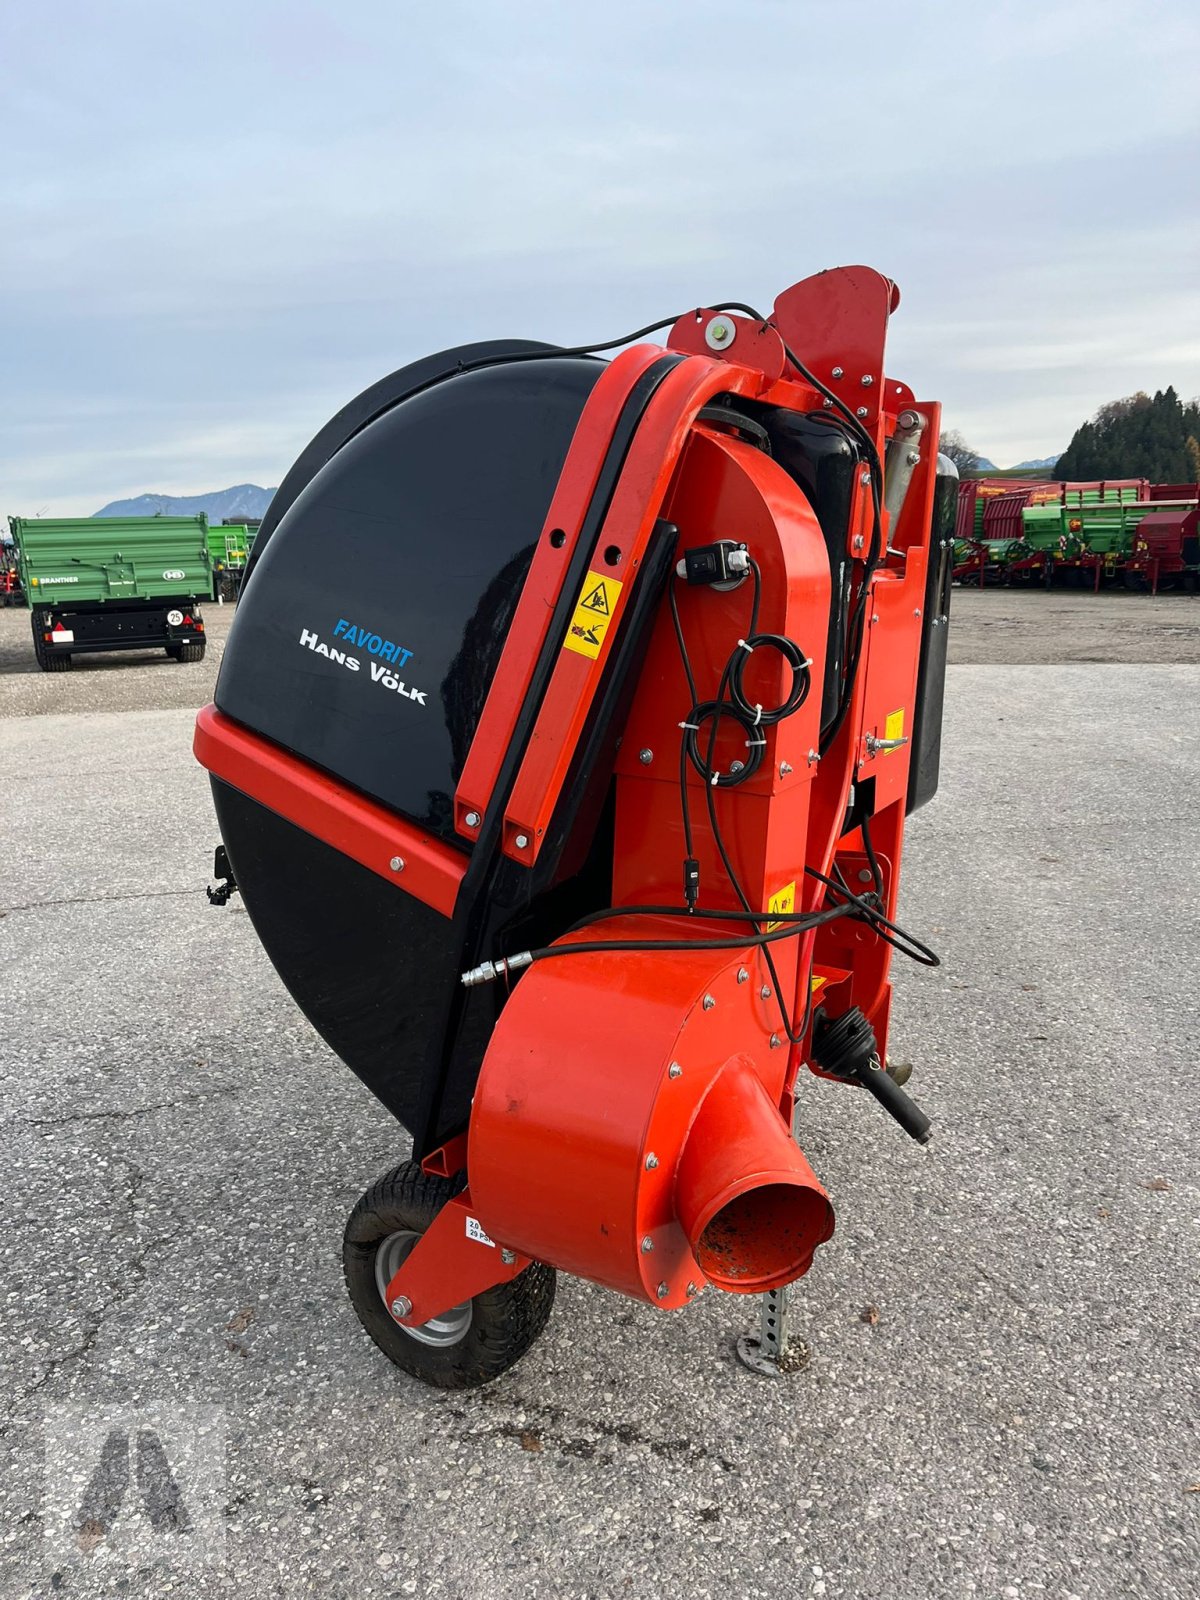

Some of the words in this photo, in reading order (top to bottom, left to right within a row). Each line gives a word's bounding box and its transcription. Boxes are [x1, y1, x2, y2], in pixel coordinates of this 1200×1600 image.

[40, 576, 79, 585] BRANTNER
[170, 613, 181, 622] 25
[333, 618, 414, 668] FAVORIT
[299, 628, 361, 672] HANS
[470, 1229, 478, 1238] 29
